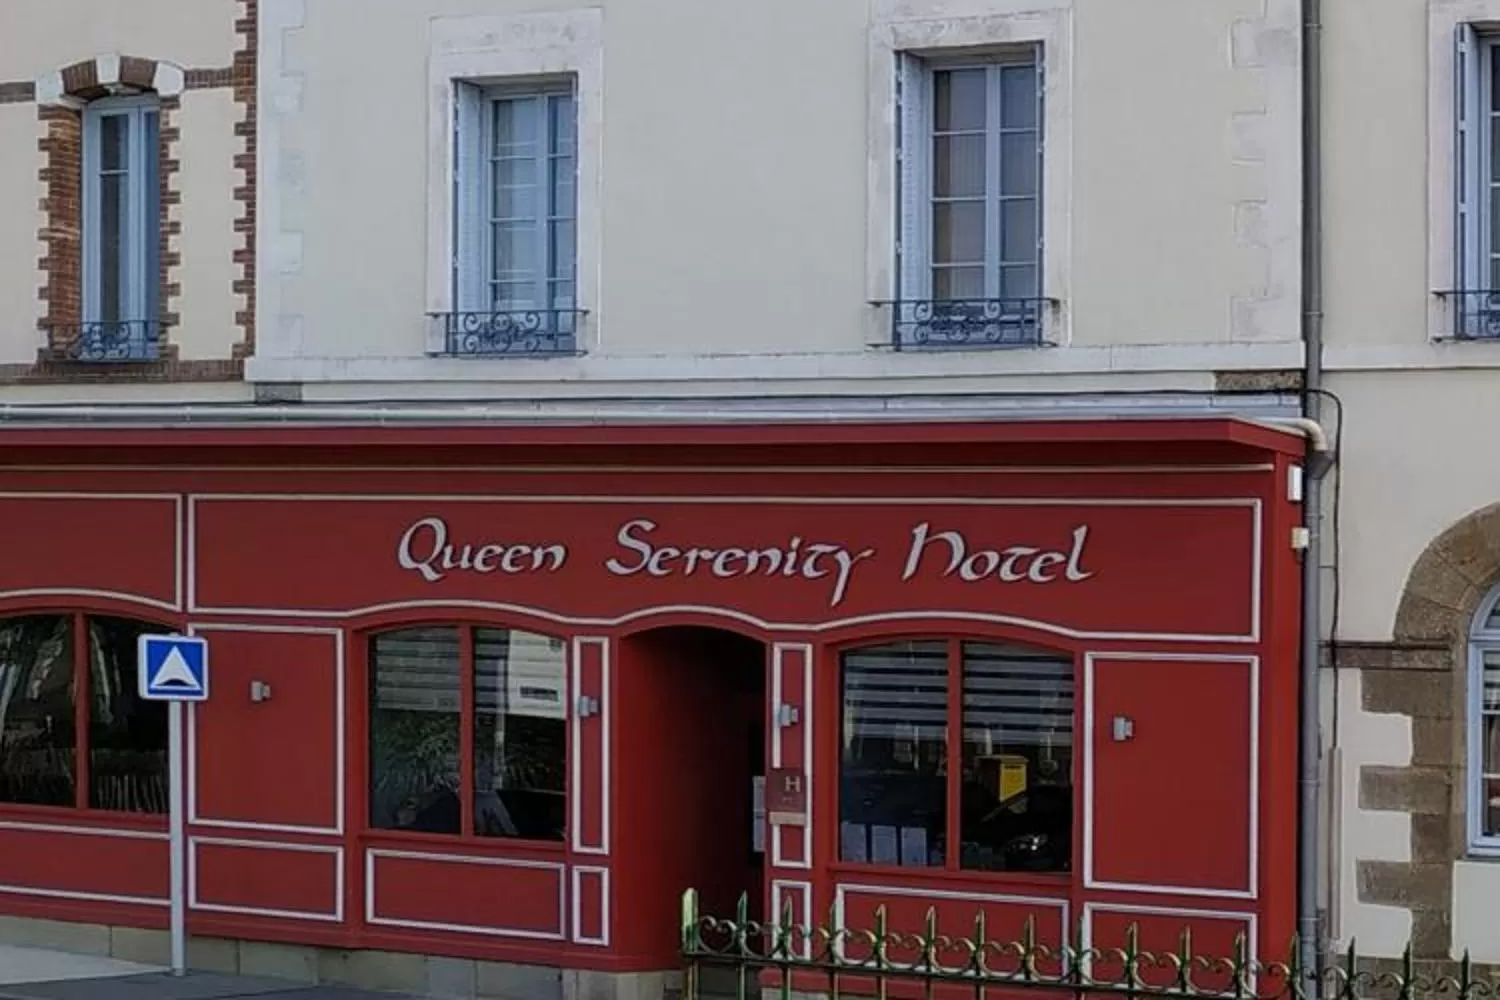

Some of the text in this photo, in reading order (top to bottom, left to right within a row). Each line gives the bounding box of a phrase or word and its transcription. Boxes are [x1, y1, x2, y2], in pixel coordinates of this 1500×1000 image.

[398, 516, 1094, 608] Queen Serenity Hotel
[784, 775, 801, 793] H
